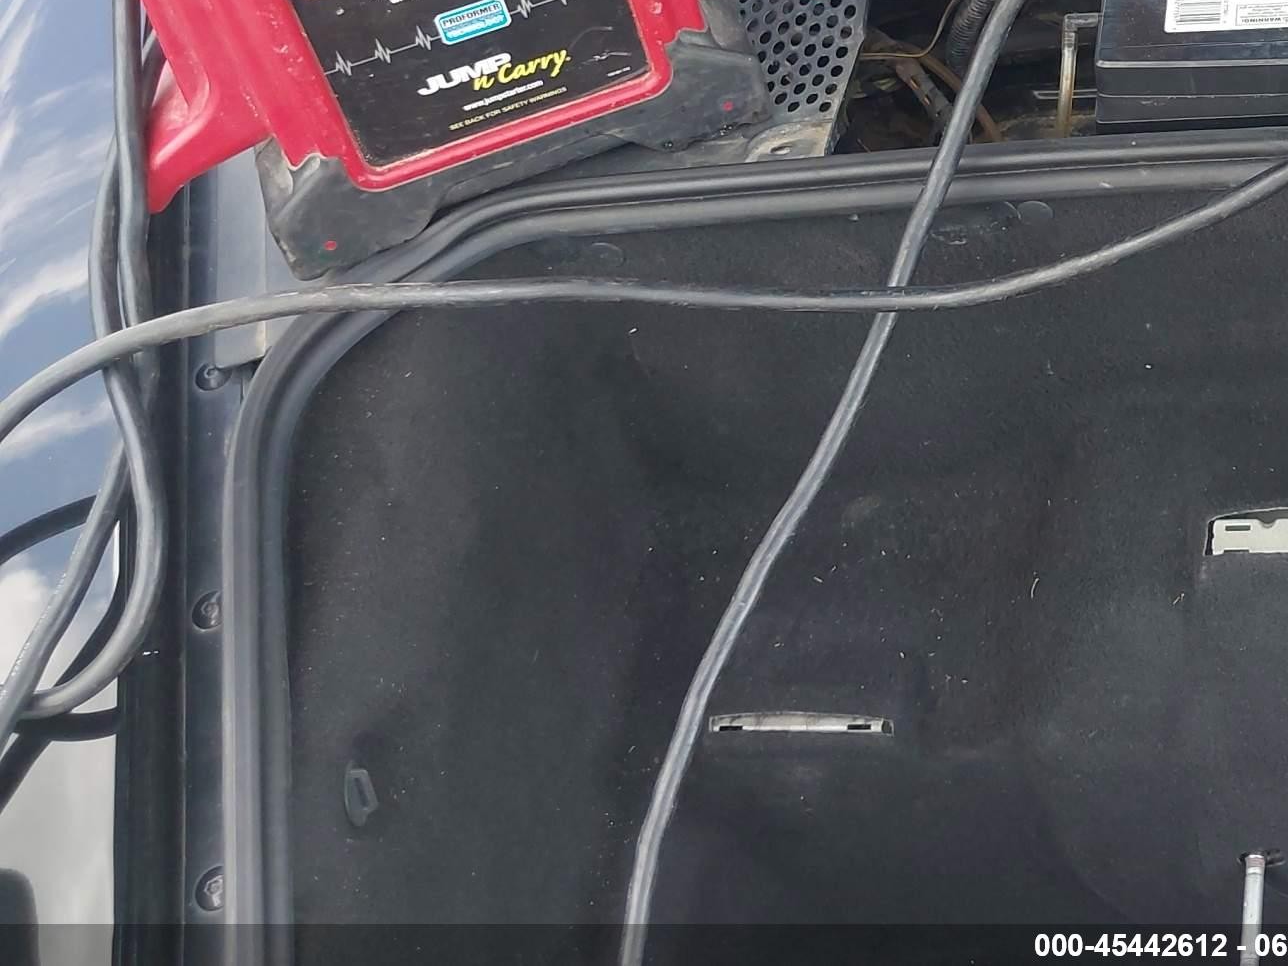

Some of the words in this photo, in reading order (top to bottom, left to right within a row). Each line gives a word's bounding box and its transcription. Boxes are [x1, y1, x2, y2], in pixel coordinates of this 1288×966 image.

[442, 3, 501, 27] PROFORMER
[417, 52, 511, 96] JUMP
[449, 121, 464, 131] SEE
[465, 115, 485, 127] BACK
[486, 109, 502, 120] FOR
[501, 100, 530, 114] SAFETY
[529, 86, 568, 104] WARNINGS
